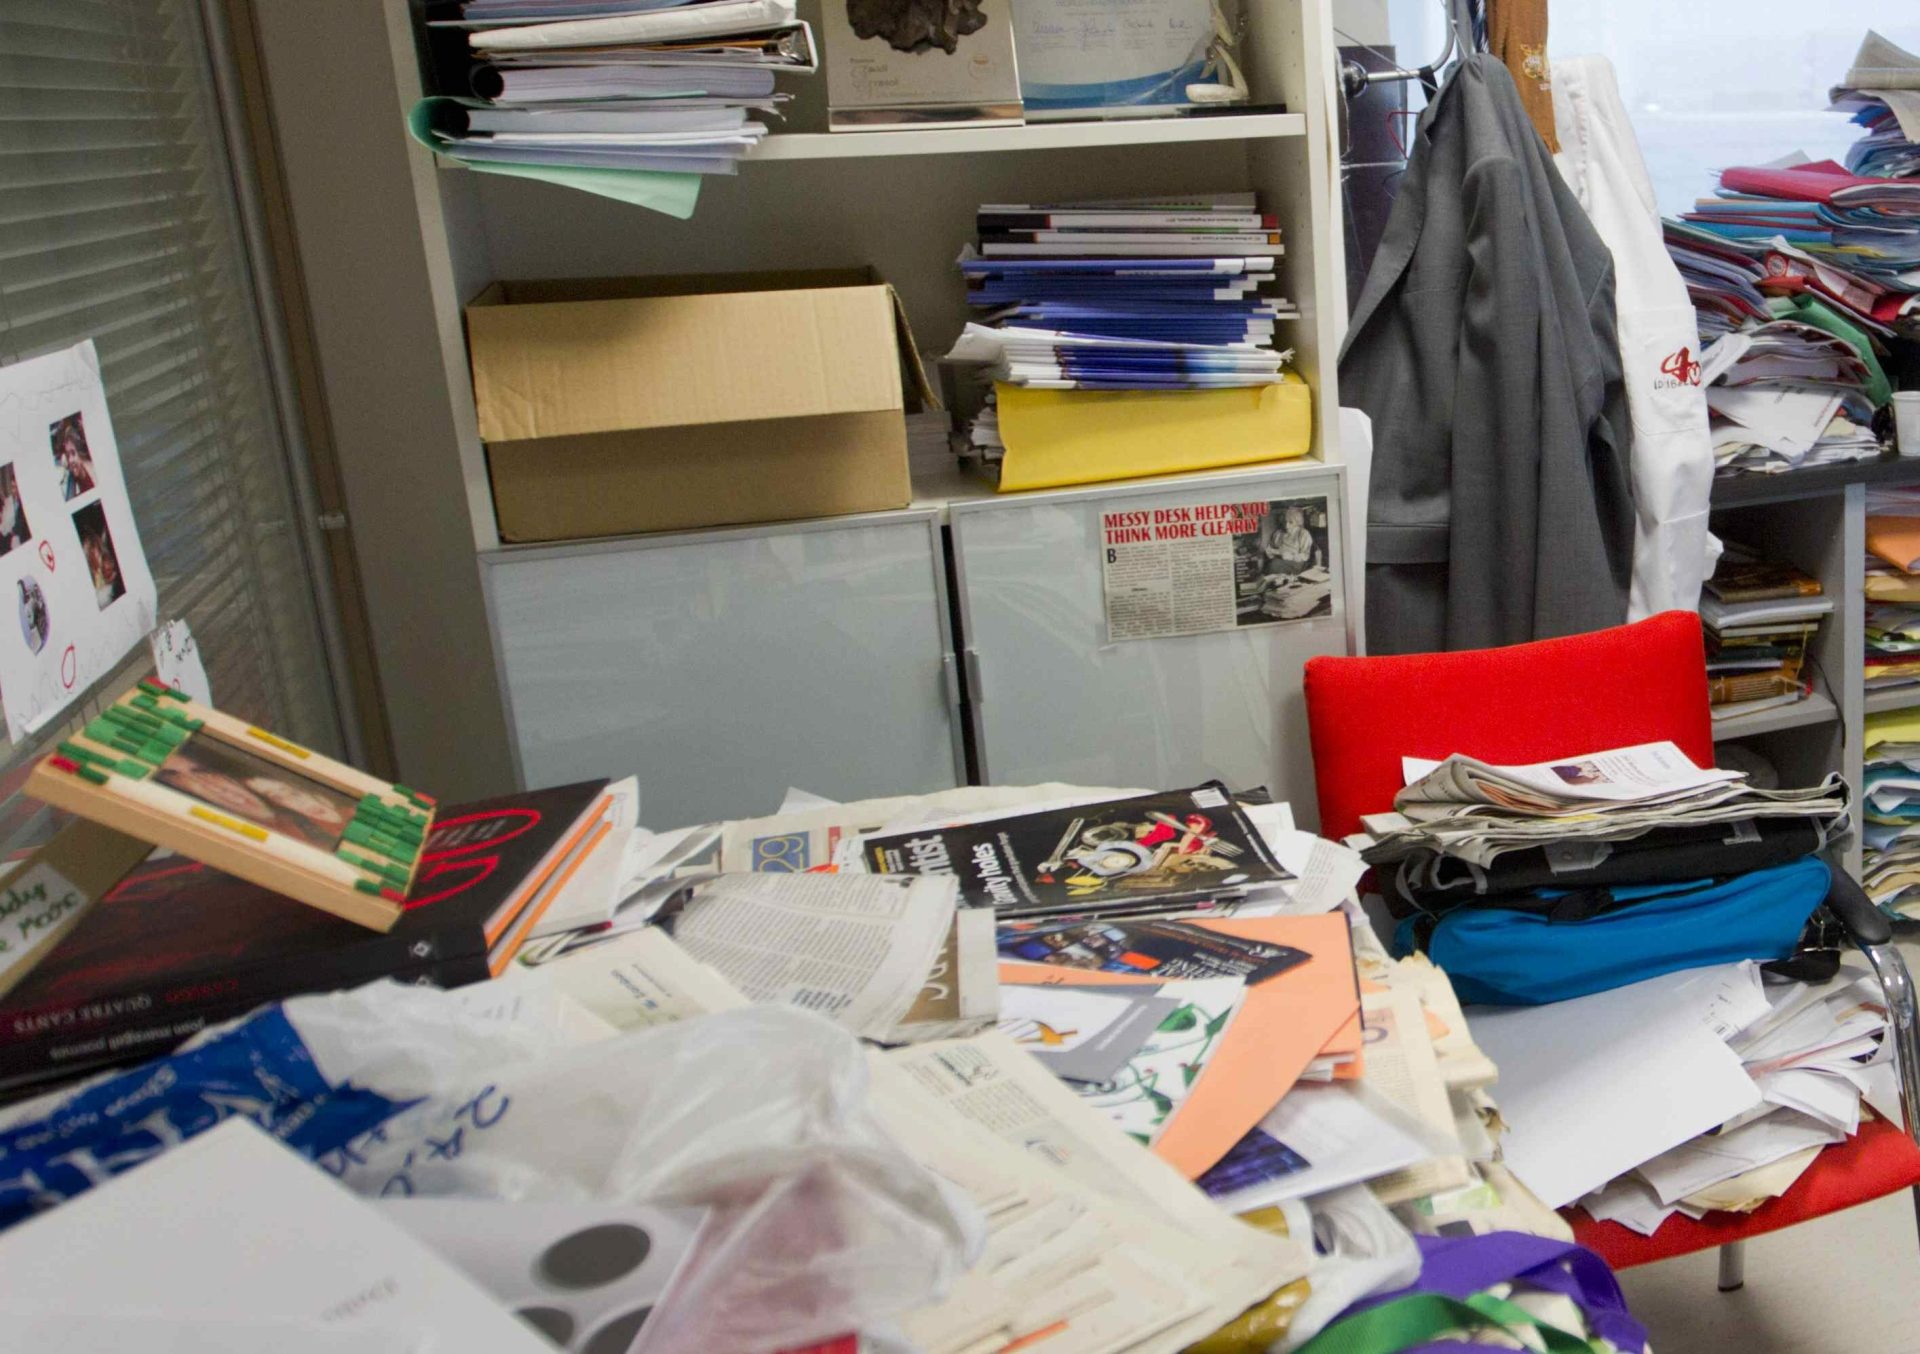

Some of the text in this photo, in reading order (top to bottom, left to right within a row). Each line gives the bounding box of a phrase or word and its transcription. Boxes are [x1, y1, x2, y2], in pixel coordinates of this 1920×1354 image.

[1104, 501, 1270, 528] MESSY DESK HELPS YOU
[1106, 518, 1258, 544] THINK MORE CLEARLY
[971, 842, 1002, 878] holes
